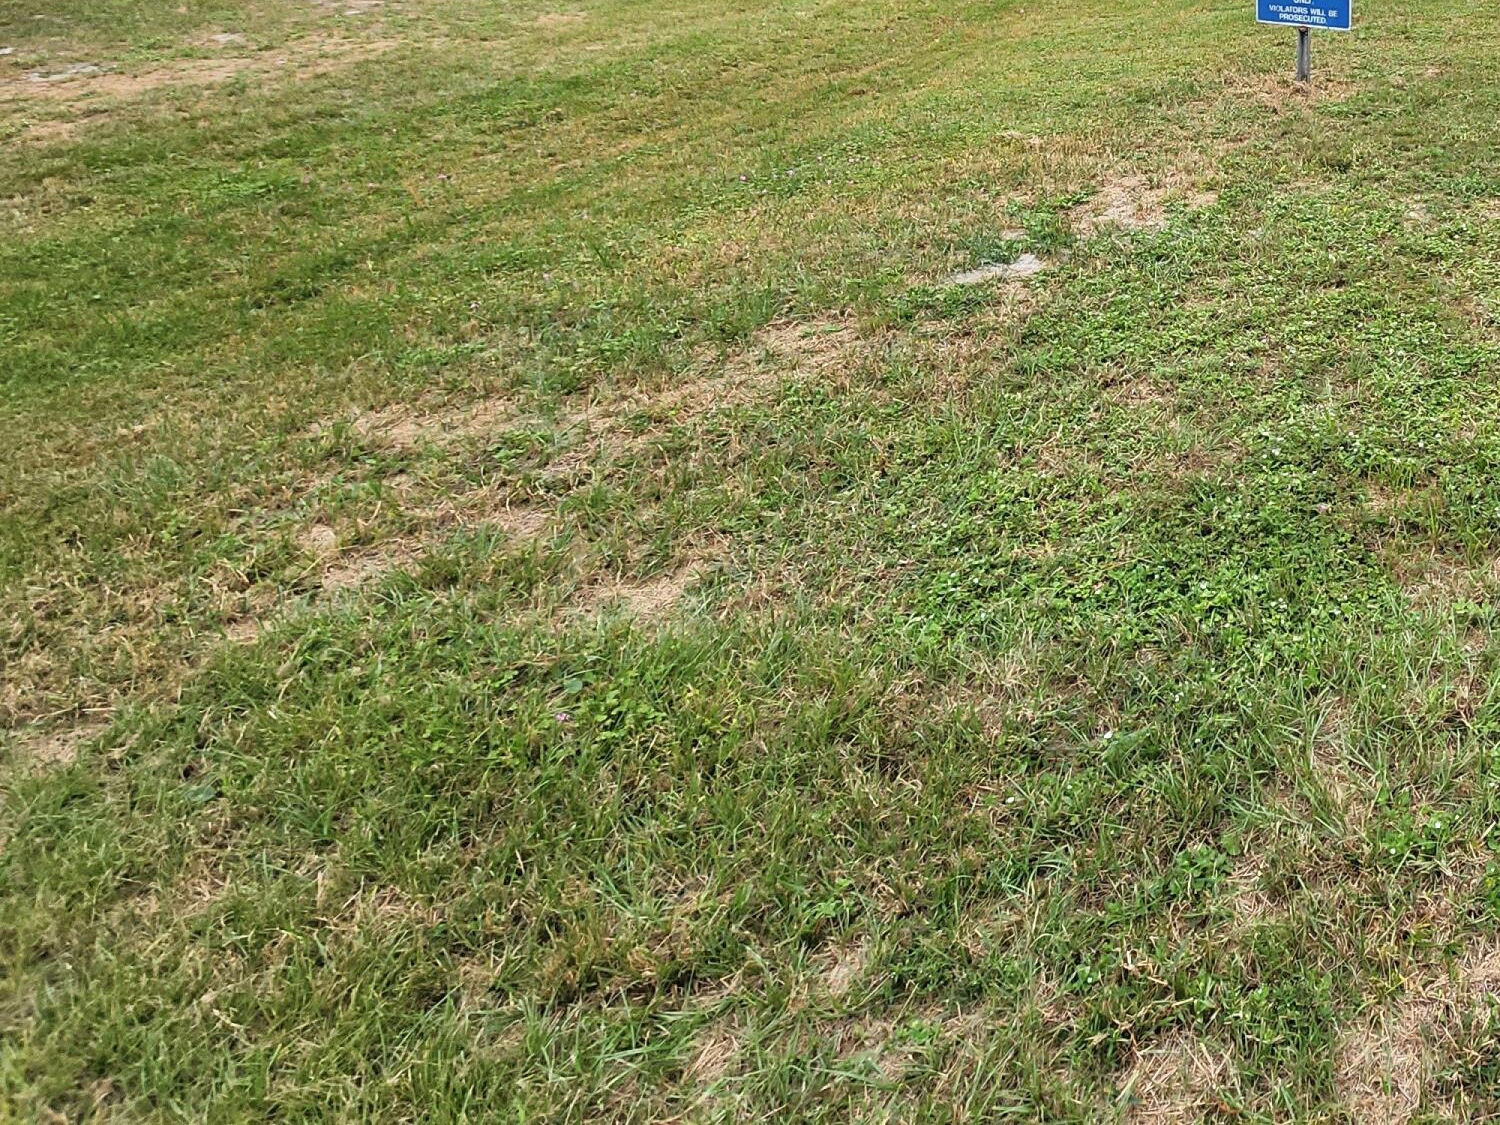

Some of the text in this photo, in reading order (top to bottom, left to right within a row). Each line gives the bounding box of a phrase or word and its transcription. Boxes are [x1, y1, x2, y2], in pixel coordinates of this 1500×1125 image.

[1269, 5, 1338, 18] VIOLATORS WILL BE
